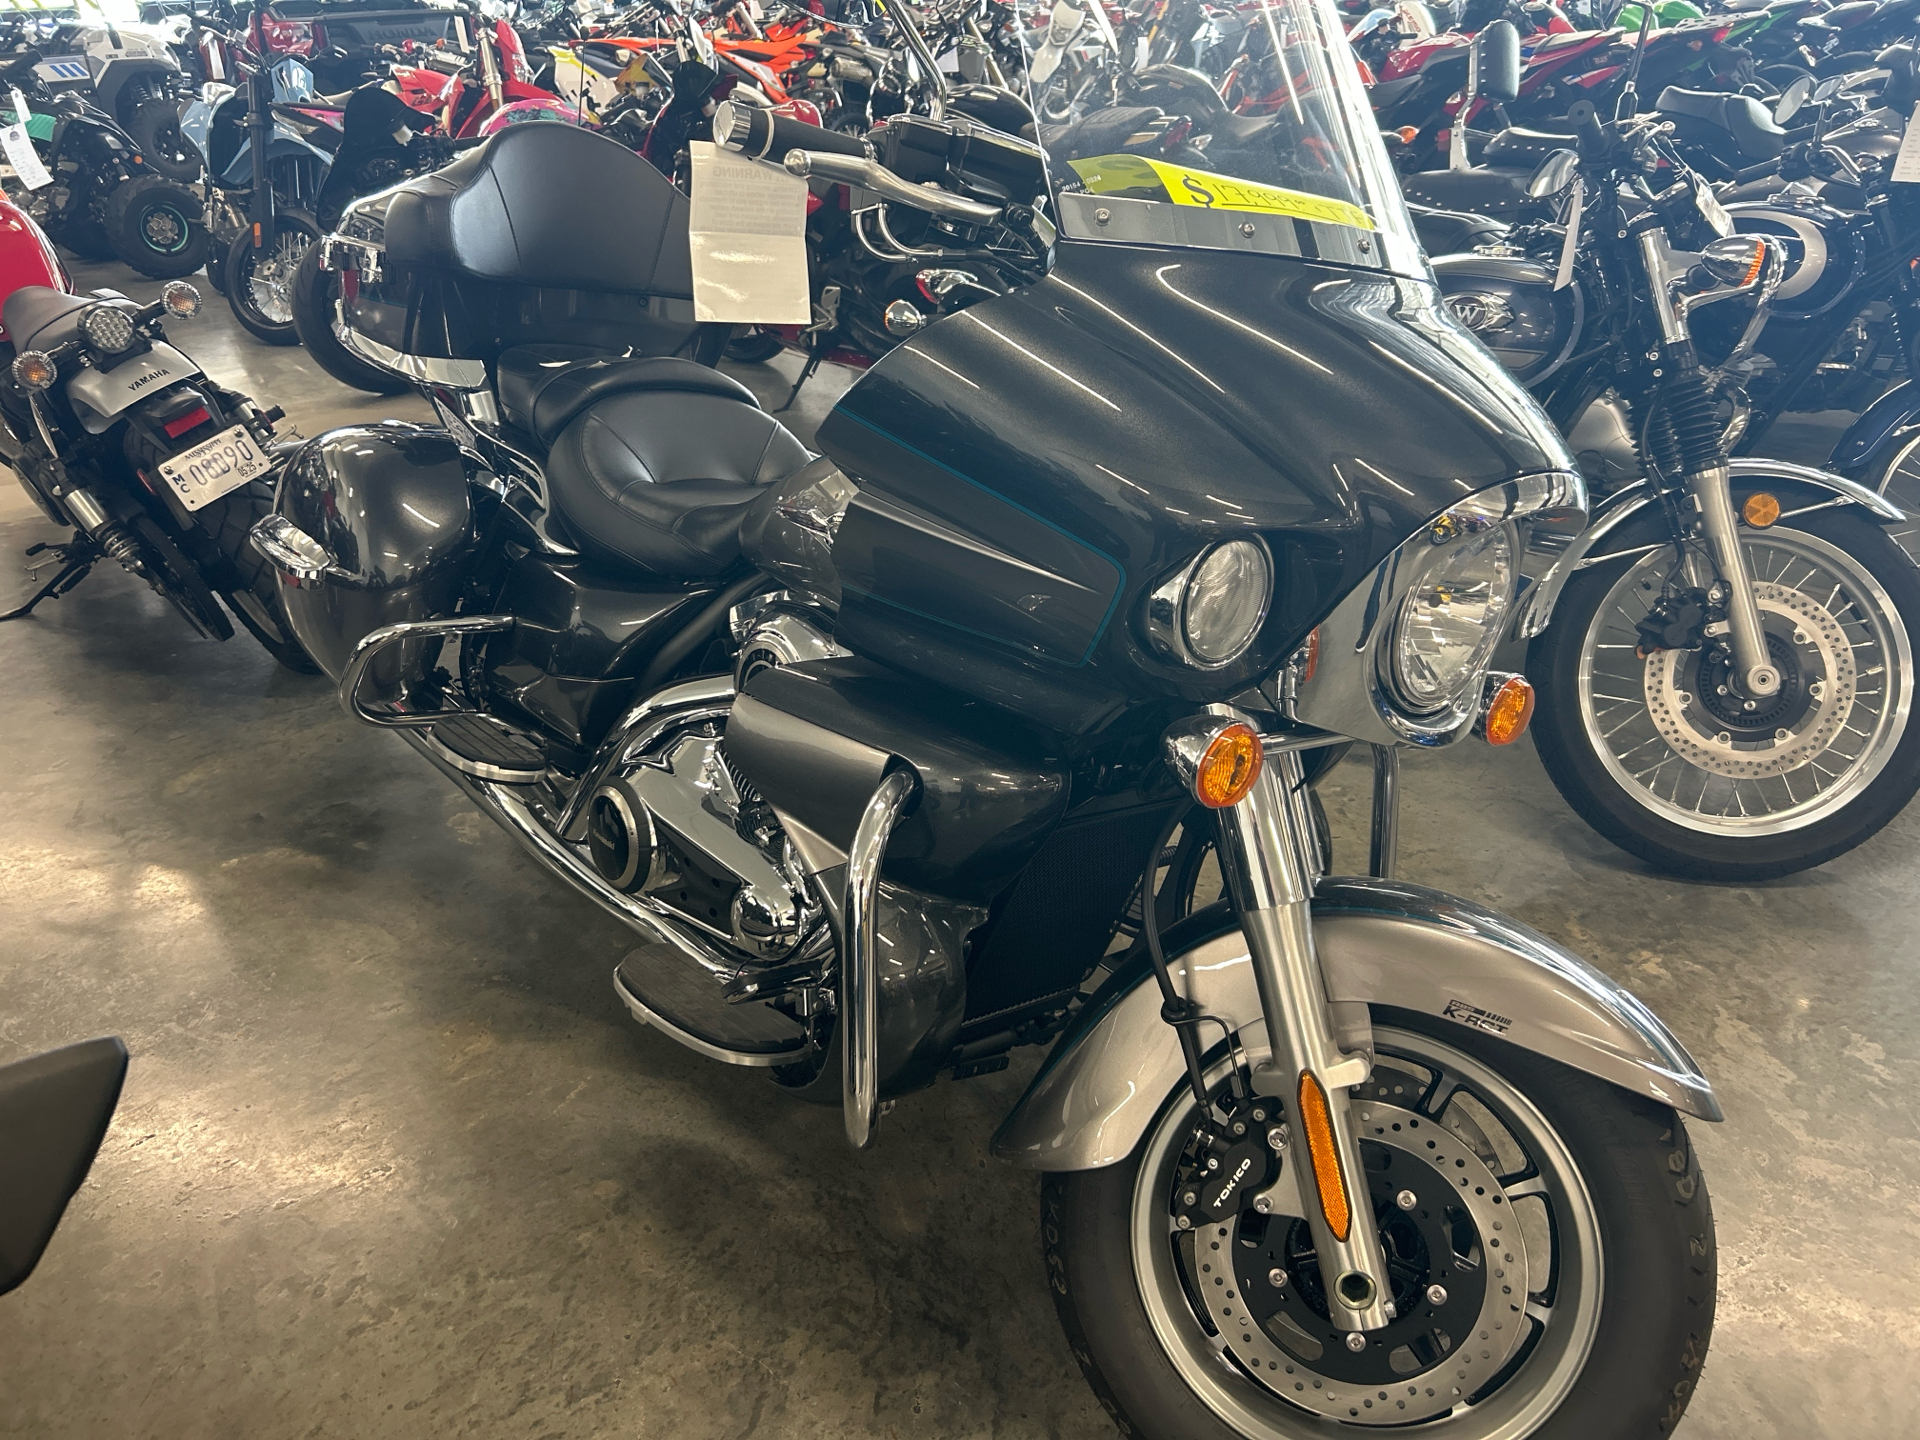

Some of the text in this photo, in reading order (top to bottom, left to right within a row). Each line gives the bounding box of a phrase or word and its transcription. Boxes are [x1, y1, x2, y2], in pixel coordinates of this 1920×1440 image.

[1455, 303, 1486, 324] W
[128, 369, 170, 391] YAMAHA
[184, 438, 222, 461] MISSISSIPPI
[1213, 1158, 1251, 1207] TOKICO
